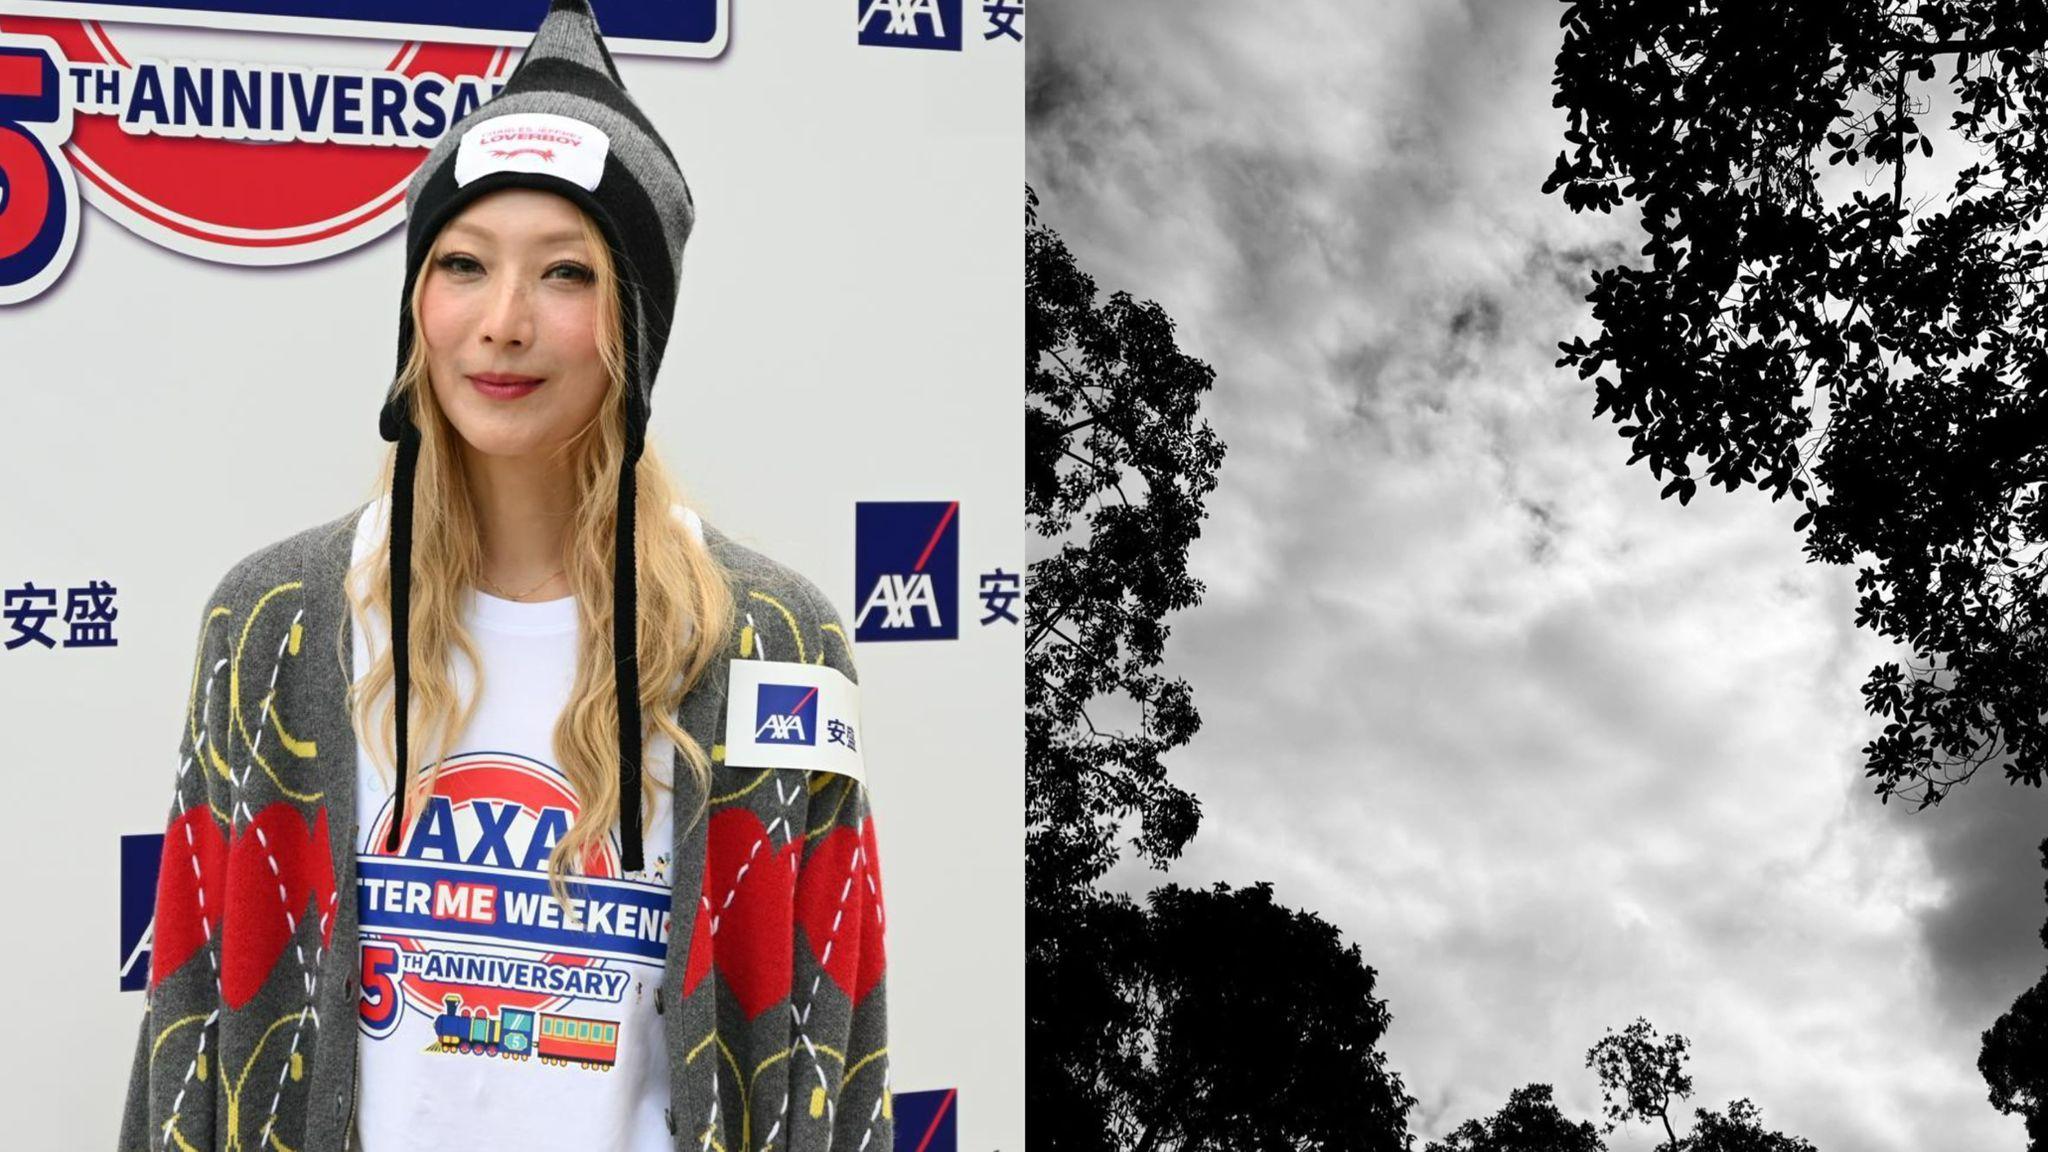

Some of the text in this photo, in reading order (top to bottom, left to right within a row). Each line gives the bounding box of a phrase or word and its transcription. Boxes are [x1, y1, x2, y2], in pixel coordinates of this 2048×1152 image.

[126, 64, 506, 139] ANNIVERSA
[480, 133, 582, 147] LOVERBOY
[3, 581, 118, 651] 安盛
[856, 567, 1020, 629] AXA 安
[755, 714, 806, 740] AXA
[405, 796, 570, 872] AXA
[424, 954, 623, 997] ANNIVERSARY
